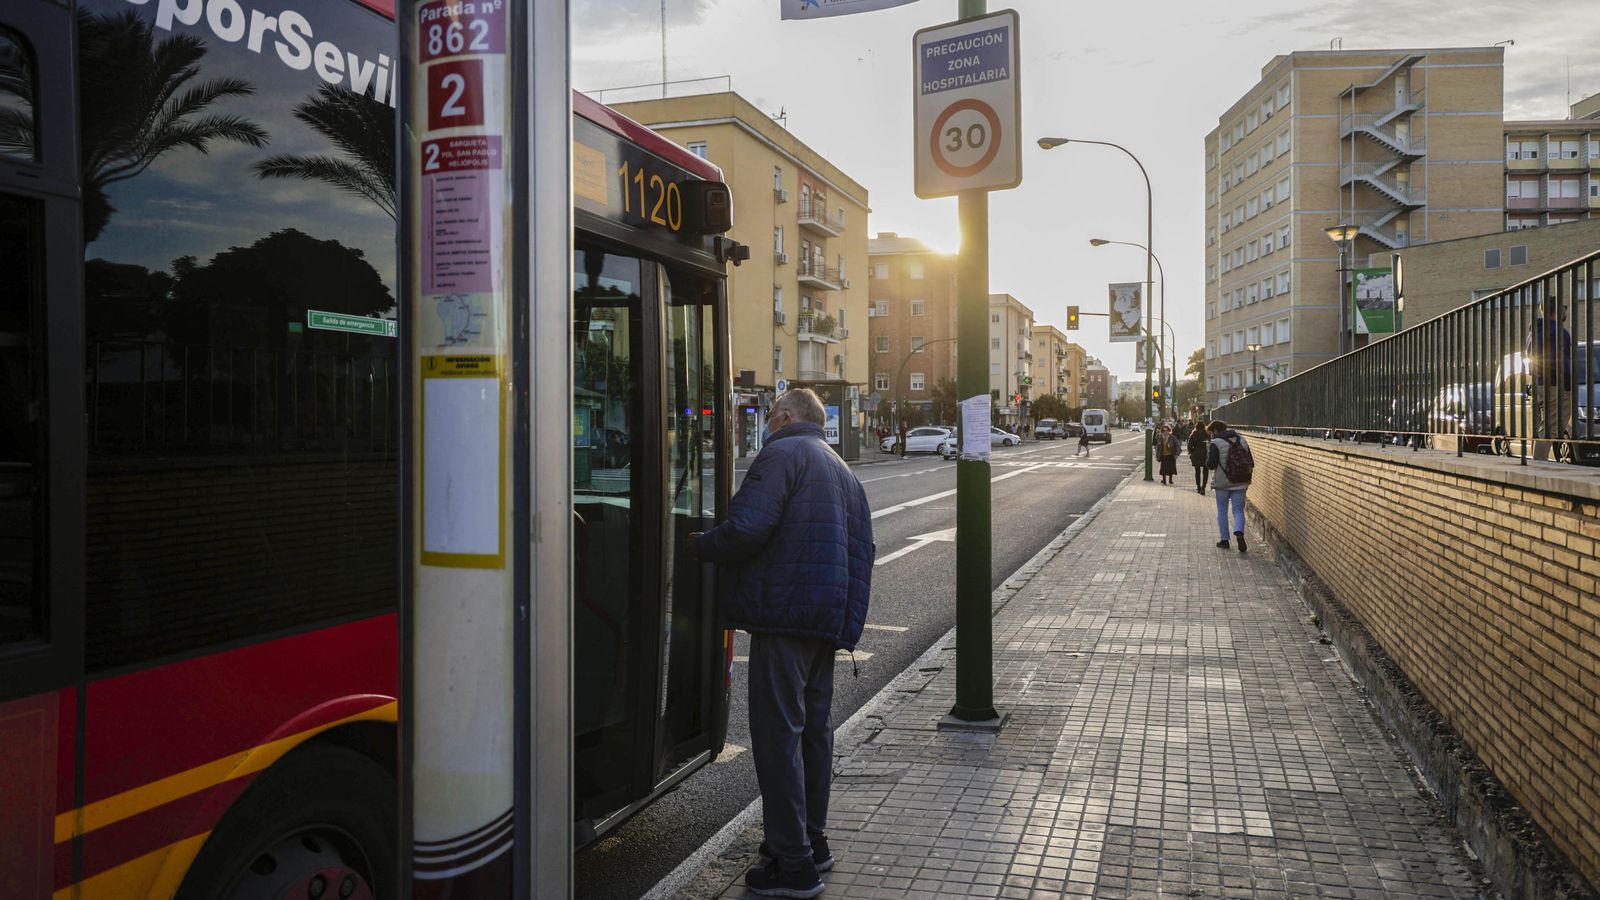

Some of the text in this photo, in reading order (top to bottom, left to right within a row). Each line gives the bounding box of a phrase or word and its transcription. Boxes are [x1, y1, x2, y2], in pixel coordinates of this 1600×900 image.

[420, 1, 476, 24] Parada
[428, 18, 490, 56] 862
[926, 32, 1003, 58] PRECAUCIÓN
[948, 56, 981, 71] ZONA
[923, 67, 1007, 93] HOSPITALARIA
[440, 73, 466, 118] 2
[945, 123, 986, 153] 30
[425, 143, 440, 171] 2
[618, 160, 682, 231] 1120
[322, 316, 339, 325] Salida
[346, 320, 375, 329] emergencia
